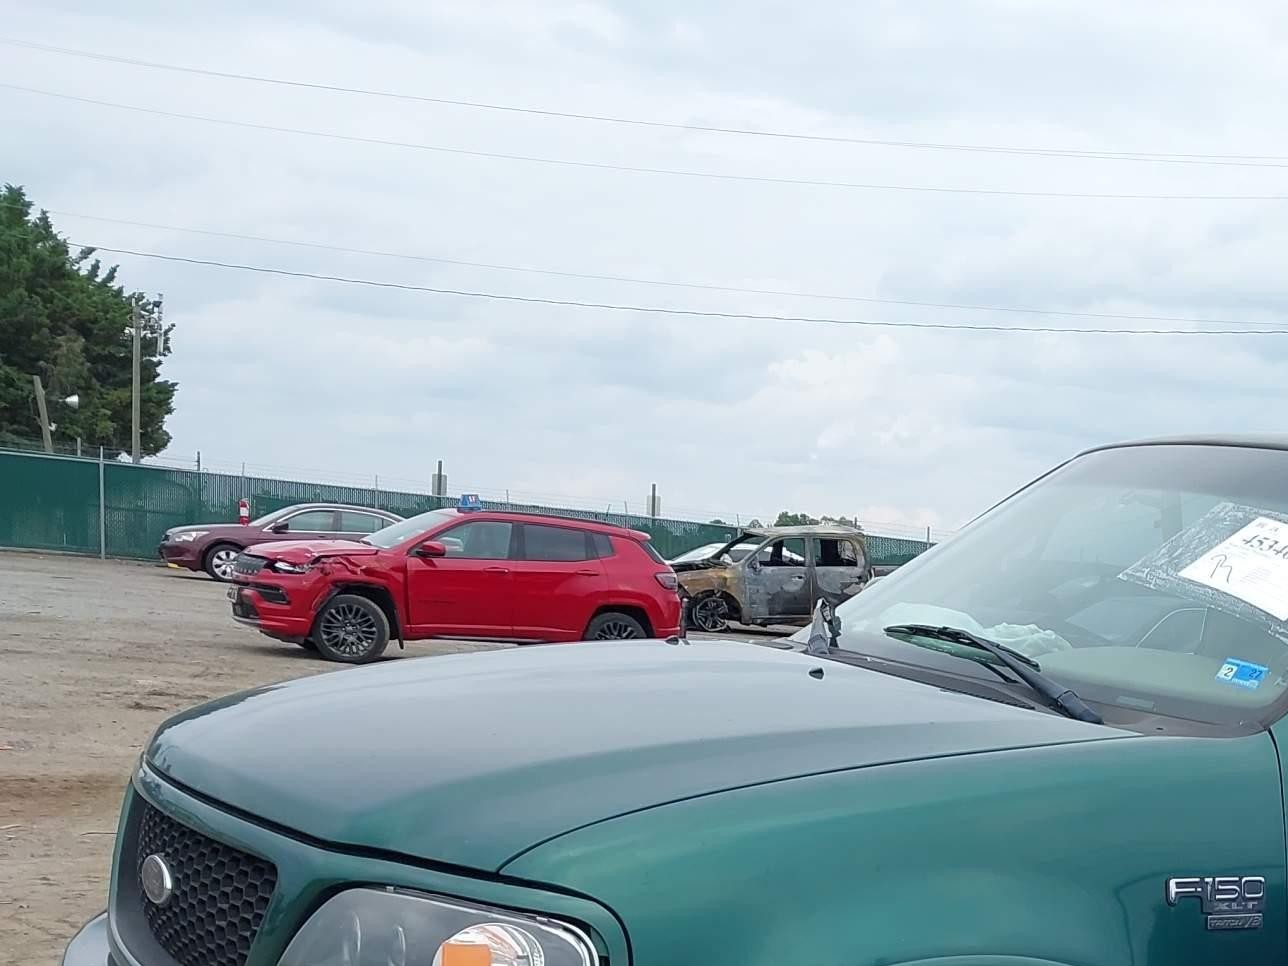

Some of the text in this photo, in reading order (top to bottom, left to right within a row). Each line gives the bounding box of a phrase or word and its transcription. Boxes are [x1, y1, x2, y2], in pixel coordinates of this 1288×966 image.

[1248, 668, 1264, 679] 27
[1169, 876, 1265, 904] F-150
[1214, 901, 1258, 910] XLT
